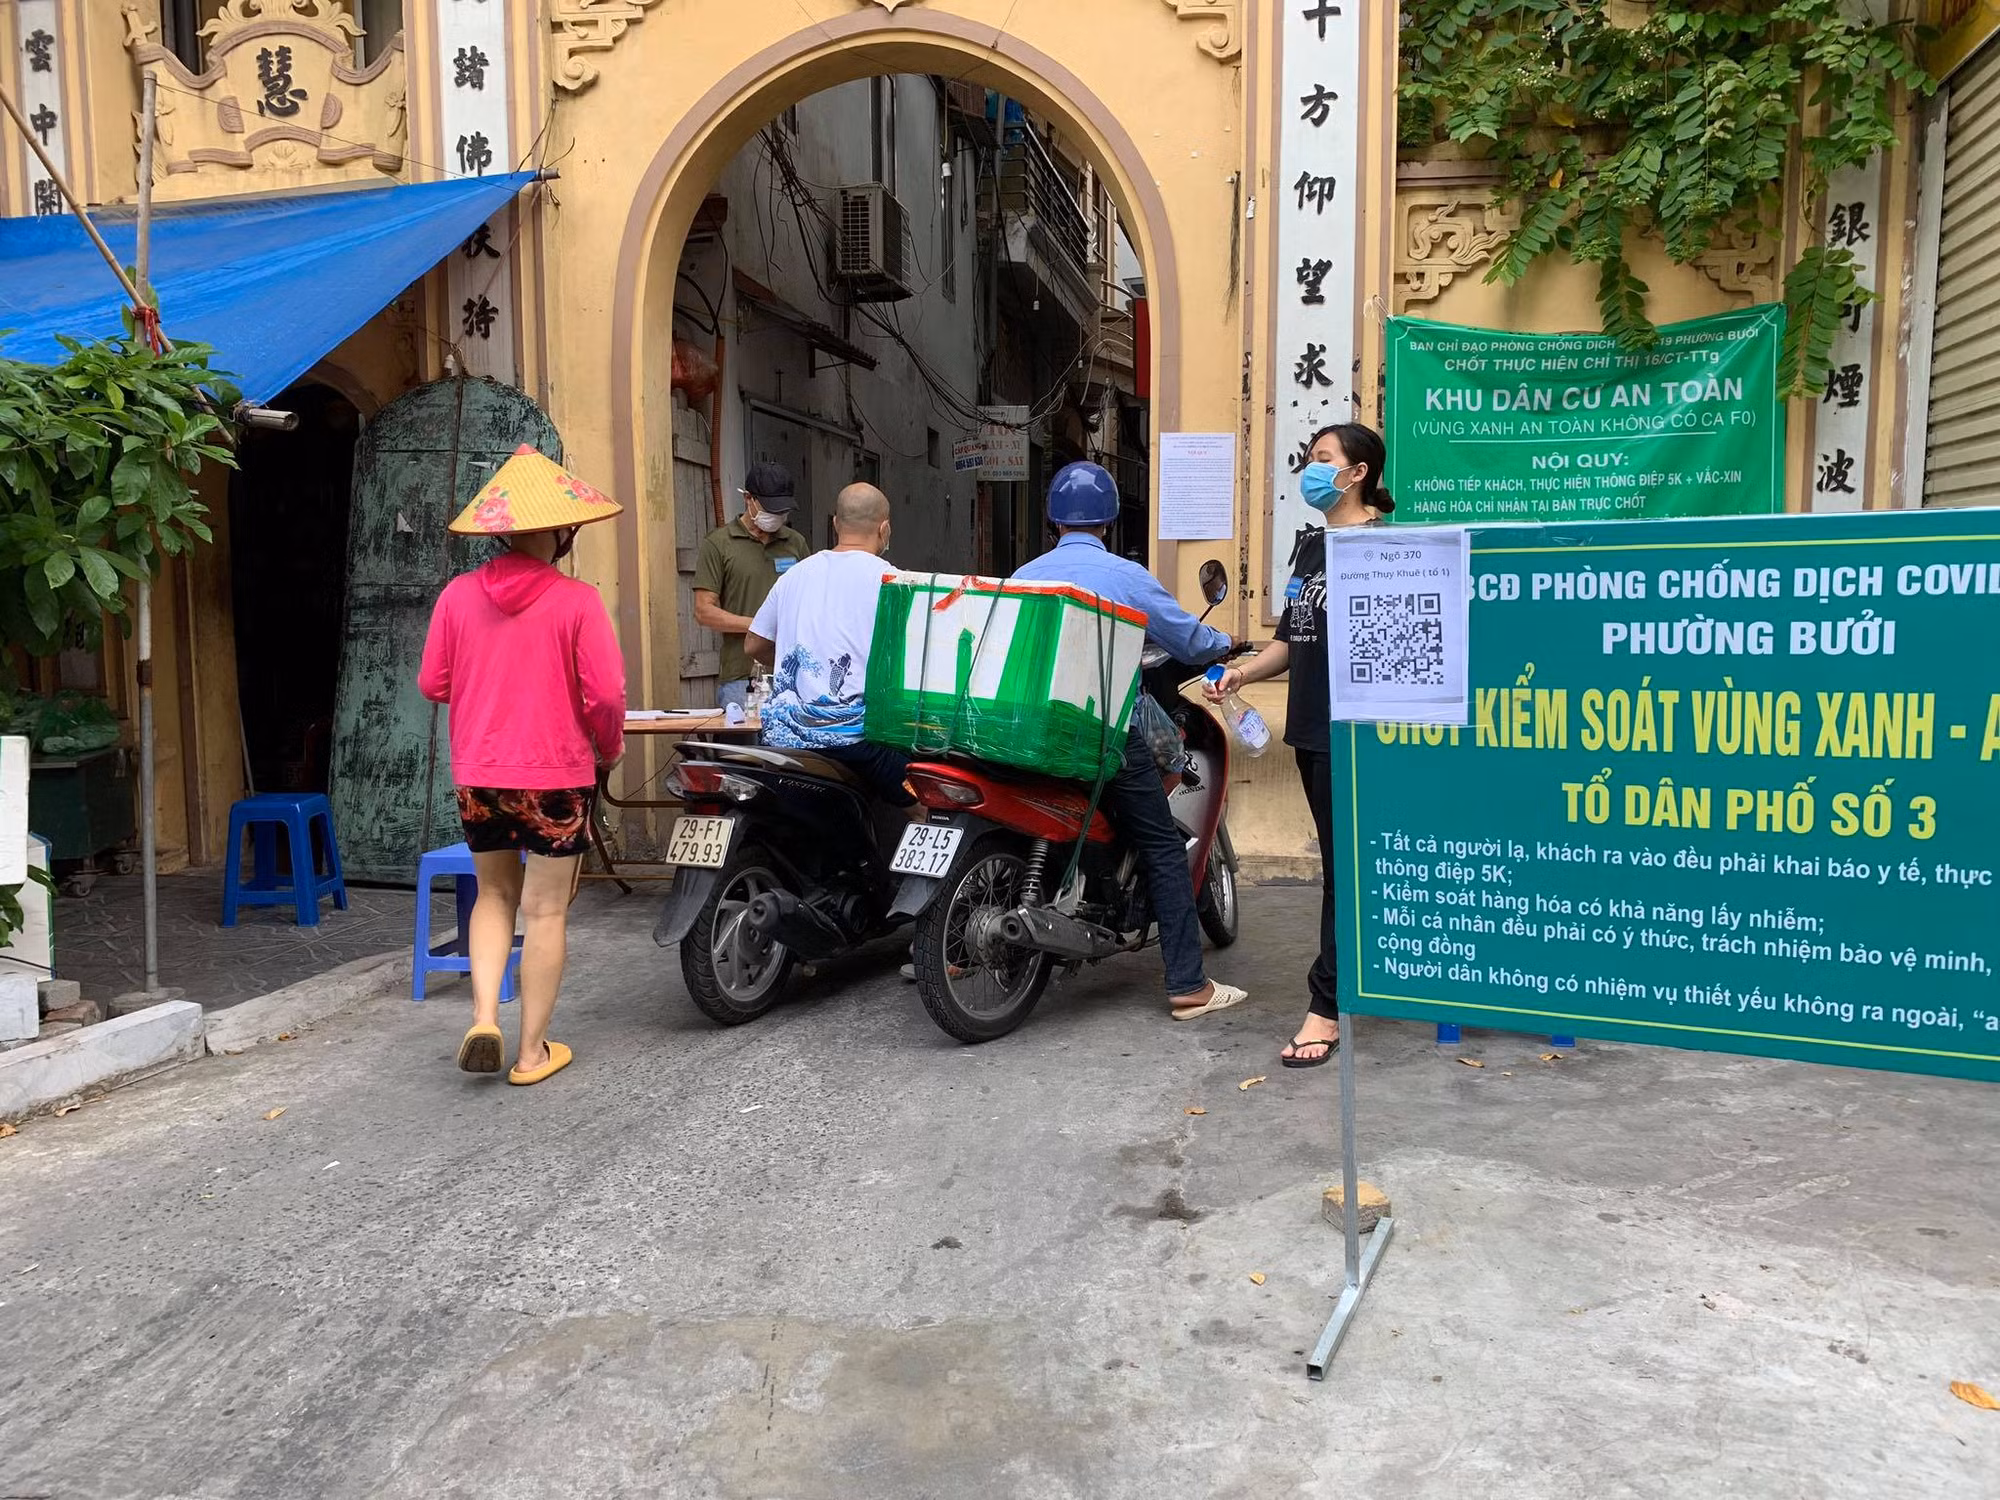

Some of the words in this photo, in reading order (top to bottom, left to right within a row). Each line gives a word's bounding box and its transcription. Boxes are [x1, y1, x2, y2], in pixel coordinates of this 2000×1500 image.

[256, 45, 308, 117] 慧
[1444, 354, 1488, 371] CHỐT
[1492, 358, 1536, 374] THỰC
[1541, 355, 1579, 372] HIỆN
[1583, 352, 1609, 369] CHỈ
[1614, 355, 1639, 370] THỊ
[1644, 350, 1720, 367] 16/CT-TTg
[1425, 388, 1482, 412] KHU
[1492, 383, 1552, 412] DÂN
[1562, 383, 1604, 410] CƯ
[1610, 384, 1651, 407] AN
[1661, 373, 1743, 404] TOÀN
[1412, 418, 1465, 438] (VÙNG
[1470, 421, 1514, 435] XANH
[1519, 421, 1543, 435] AN
[1548, 416, 1595, 435] TOÀN
[1601, 414, 1665, 432] KHÔNG
[1671, 410, 1697, 427] CÓ
[1701, 412, 1724, 427] CA
[1532, 452, 1569, 471] NỘI
[1576, 452, 1629, 468] QUY:
[1414, 476, 1455, 492] KHÔNG
[1458, 474, 1482, 491] TIẾP
[1484, 476, 1527, 492] KHÁCH,
[1530, 476, 1560, 493] THỰC
[1564, 474, 1591, 492] HIỆN
[1594, 472, 1636, 488] THÔNG
[1639, 470, 1665, 488] ĐIỆP
[1667, 472, 1682, 486] 5K
[1696, 466, 1742, 484] VẮC-XIN
[1414, 498, 1446, 513] HÀNG
[1450, 497, 1472, 512] HÓA
[1475, 496, 1494, 512] CHỈ
[1497, 497, 1528, 515] NHẬN
[1531, 499, 1549, 514] TẠI
[1552, 496, 1576, 511] BÀN
[1580, 497, 1611, 512] TRỰC
[1615, 491, 1646, 508] CHỐT
[1380, 551, 1400, 562] Ngõ
[1403, 550, 1421, 559] 370
[1532, 565, 1646, 600] PHÒNG
[1658, 558, 1780, 599] CHỐNG
[1793, 565, 1883, 603] DỊCH
[1602, 613, 1774, 655] PHƯỜNG
[1789, 609, 1896, 655] BƯỞI
[1476, 662, 1568, 749] KIỂM
[1581, 676, 1680, 753] SOÁT
[1691, 676, 1800, 756] VÙNG
[1814, 692, 1935, 759] XANH
[1950, 725, 1966, 739] -
[1562, 767, 1612, 824] TỔ
[1624, 777, 1711, 829] DÂN
[1726, 776, 1817, 833] PHỐ
[1831, 778, 1895, 837] SỐ
[1908, 796, 1936, 840] 3
[679, 818, 723, 841] 29-F1
[908, 826, 954, 850] 29-L5
[669, 841, 723, 863] 479.93
[895, 848, 950, 874] 383.17
[1381, 830, 1410, 851] Tất
[1415, 835, 1437, 853] cả
[1444, 838, 1501, 859] người
[1508, 840, 1530, 862] lạ,
[1536, 842, 1597, 863] khách
[1603, 849, 1622, 864] ra
[1629, 847, 1666, 867] vào
[1673, 846, 1712, 870] đều
[1719, 852, 1766, 875] phải
[1773, 855, 1820, 876] khai
[1828, 857, 1870, 879] báo
[1878, 864, 1891, 885] y
[1898, 857, 1927, 885] tế,
[1935, 863, 1992, 889] thực
[1376, 857, 1429, 882] thông
[1434, 861, 1475, 885] điệp
[1481, 865, 1512, 886] 5K;
[1383, 880, 1429, 903] Kiểm
[1435, 888, 1476, 907] soát
[1482, 889, 1529, 915] hàng
[1536, 893, 1571, 914] hóa
[1578, 898, 1602, 916] có
[1609, 899, 1645, 919] khả
[1652, 903, 1704, 928] năng
[1711, 902, 1742, 931] lấy
[1749, 907, 1824, 936] nhiễm;
[1377, 933, 1423, 956] cộng
[1428, 933, 1476, 961] đồng
[1383, 906, 1416, 927] Mỗi
[1421, 911, 1443, 929] cá
[1449, 914, 1496, 934] nhân
[1502, 915, 1537, 937] đều
[1543, 921, 1586, 942] phải
[1592, 925, 1616, 943] có
[1622, 927, 1635, 949] ý
[1641, 928, 1694, 953] thức,
[1702, 933, 1756, 954] trách
[1764, 937, 1832, 963] nhiệm
[1840, 943, 1882, 965] bảo
[1890, 947, 1917, 972] vệ
[1384, 957, 1442, 980] Người
[1448, 963, 1482, 983] dân
[1489, 966, 1549, 993] không
[1555, 974, 1578, 992] có
[1585, 976, 1646, 1001] nhiệm
[1652, 985, 1677, 1005] vụ
[1684, 983, 1732, 1007] thiết
[1738, 986, 1776, 1012] yếu
[1784, 993, 1854, 1023] không
[1862, 1004, 1884, 1021] ra
[1892, 1006, 1964, 1031] ngoài,
